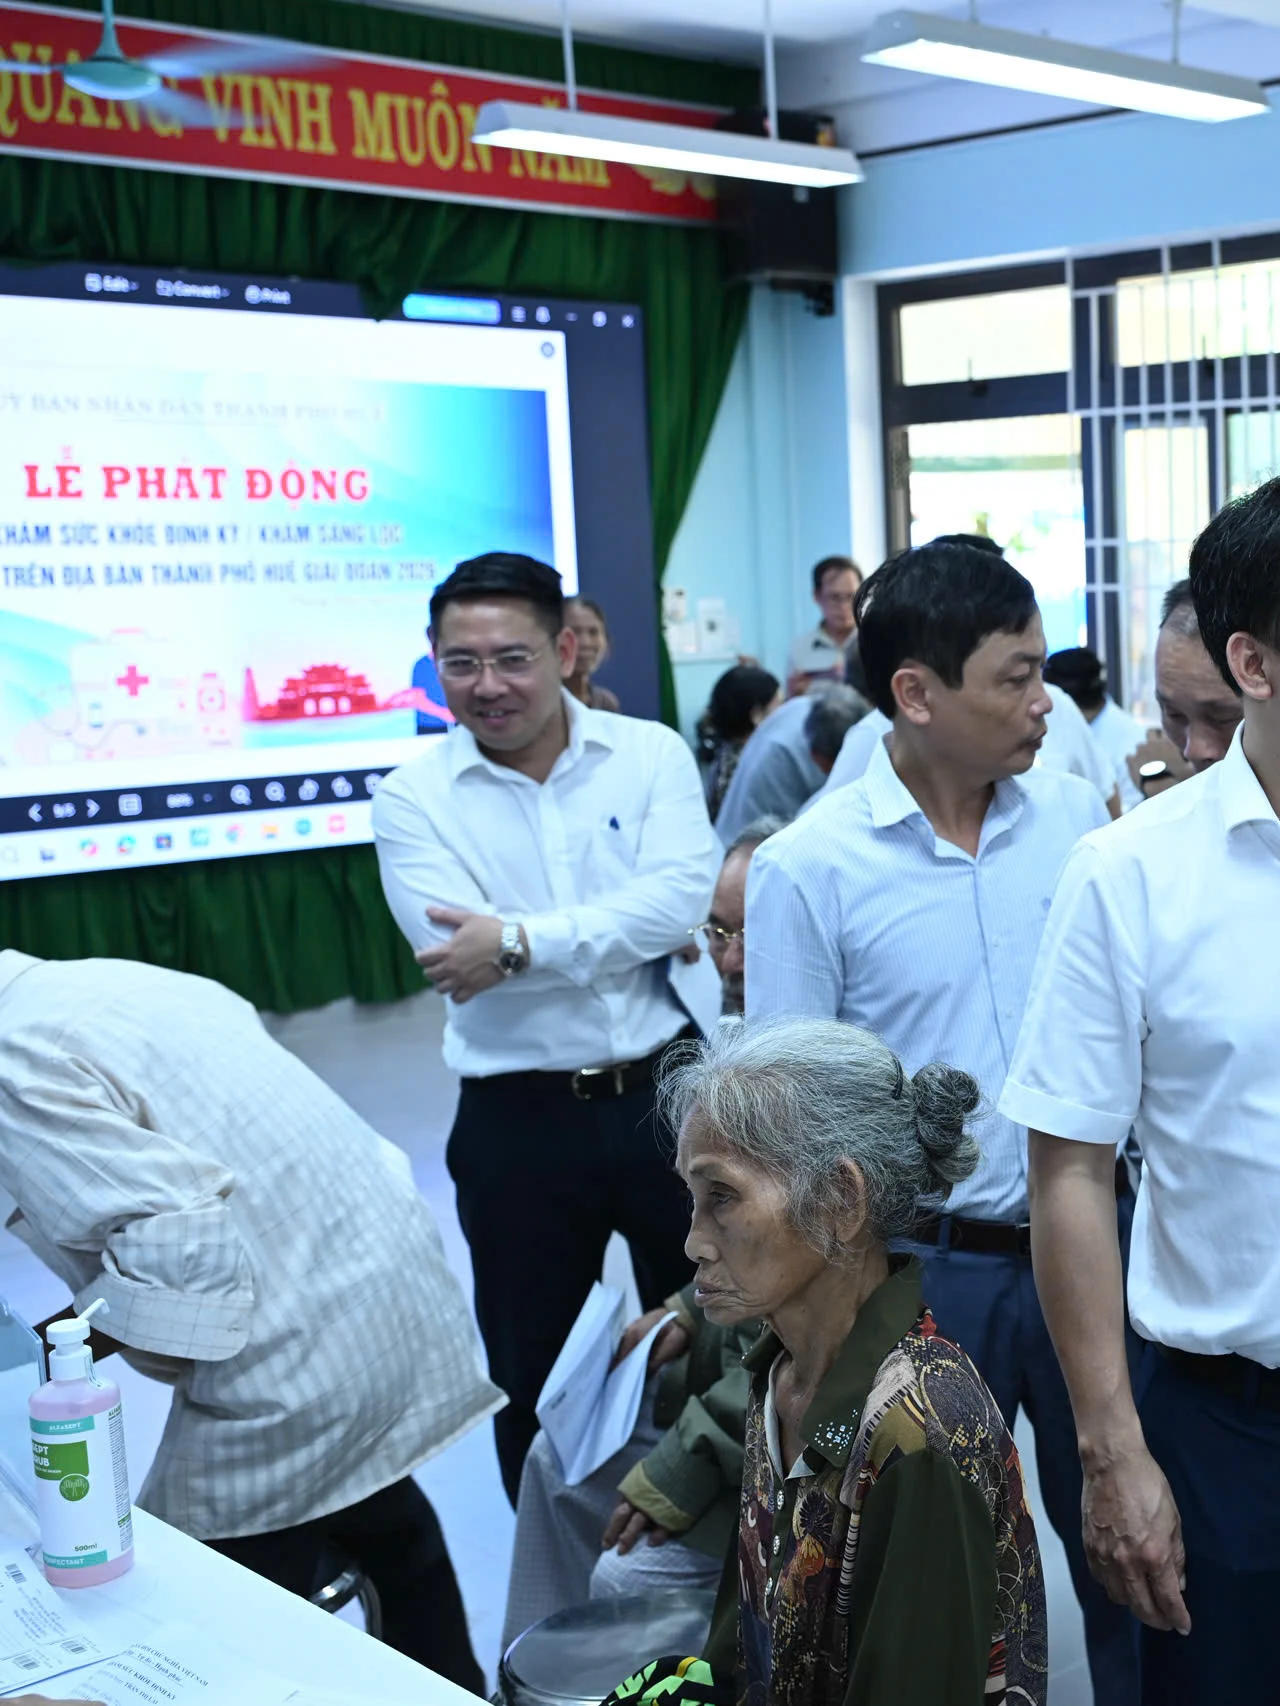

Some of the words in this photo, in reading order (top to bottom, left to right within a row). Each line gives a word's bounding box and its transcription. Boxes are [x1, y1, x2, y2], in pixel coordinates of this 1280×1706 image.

[201, 72, 337, 155] VINH
[349, 80, 492, 173] MUÔN
[74, 1544, 98, 1552] 500ml
